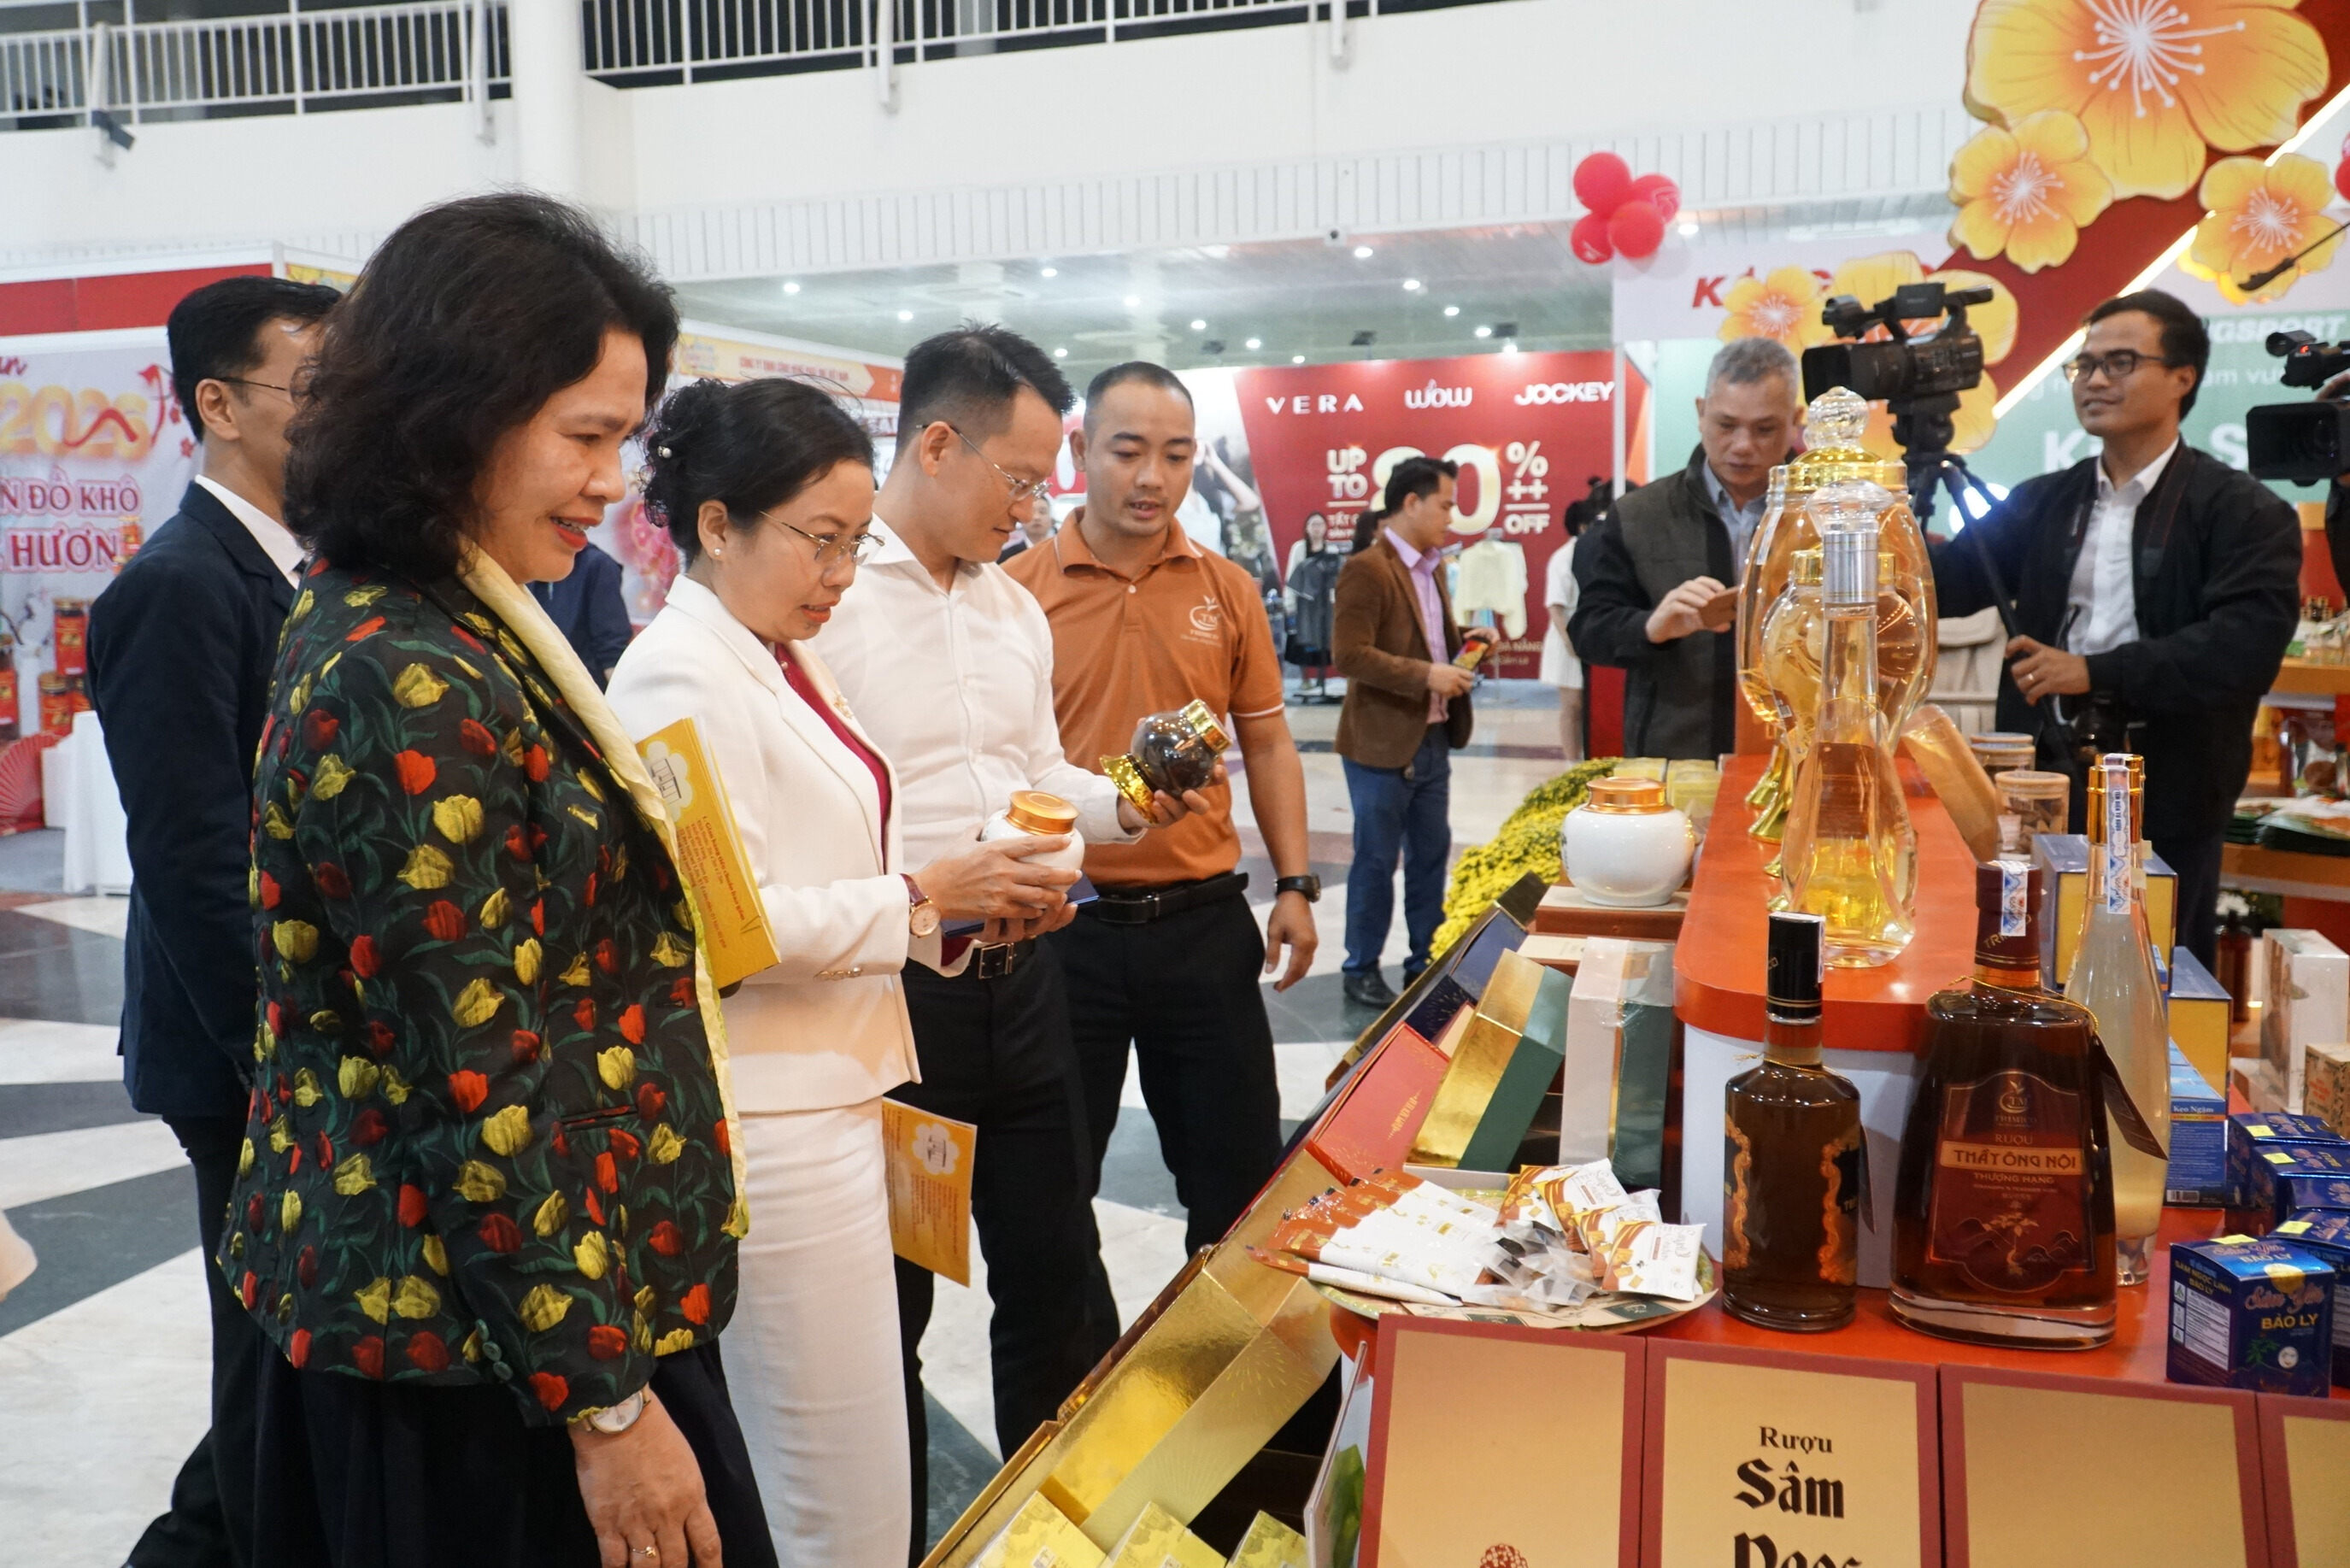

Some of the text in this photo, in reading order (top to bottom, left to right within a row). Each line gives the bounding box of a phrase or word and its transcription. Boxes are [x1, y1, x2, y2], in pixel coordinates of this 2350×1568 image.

[1266, 393, 1364, 414] VERA
[1404, 381, 1473, 409] WOW
[1513, 381, 1615, 406] JOCKEY
[1327, 448, 1367, 473] UP
[79, 475, 138, 511] KHÔ
[1327, 473, 1368, 498] TO
[1503, 513, 1551, 535] OFF
[10, 528, 117, 567] HƯƠN
[1954, 1148, 2077, 1171] THẦY ÔNG NỘI
[2261, 1313, 2318, 1330] BẢO LY
[1760, 1425, 1834, 1454] Rượu
[1733, 1458, 1844, 1519] Sâm
